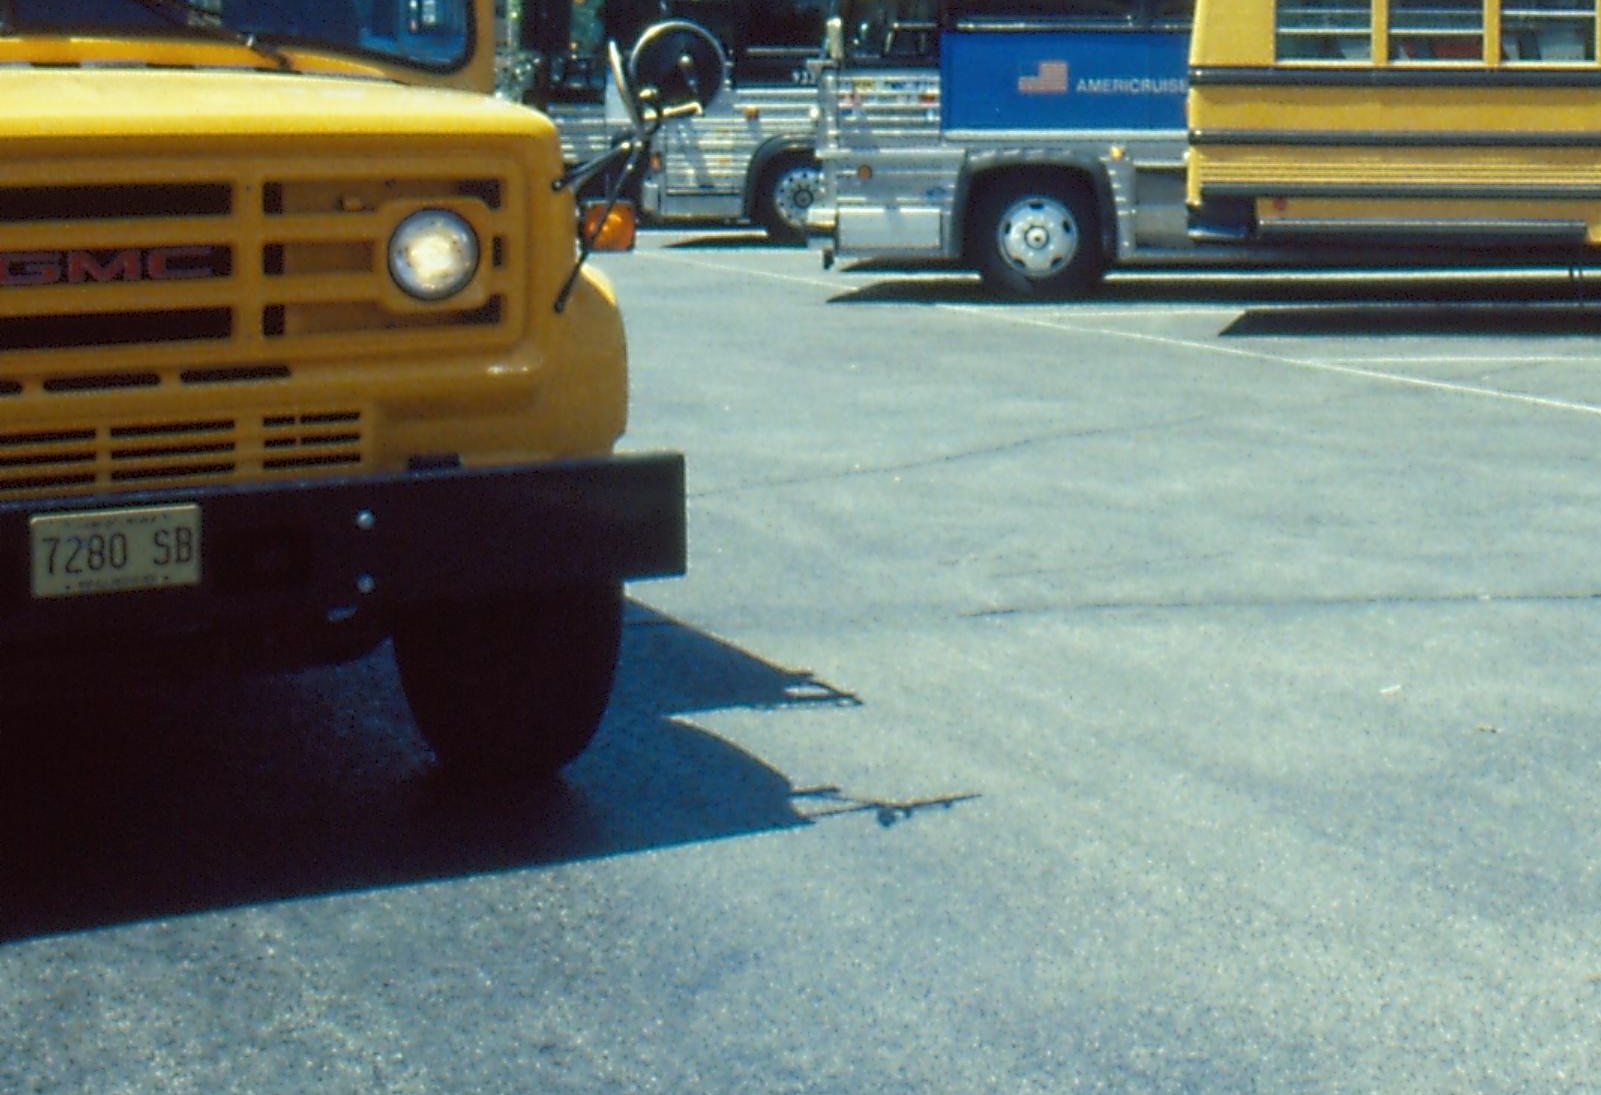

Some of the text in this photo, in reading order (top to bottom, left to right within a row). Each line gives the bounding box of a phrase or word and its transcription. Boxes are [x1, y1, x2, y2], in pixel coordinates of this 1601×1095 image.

[0, 246, 211, 285] GMC
[43, 526, 192, 575] 7280 SB
